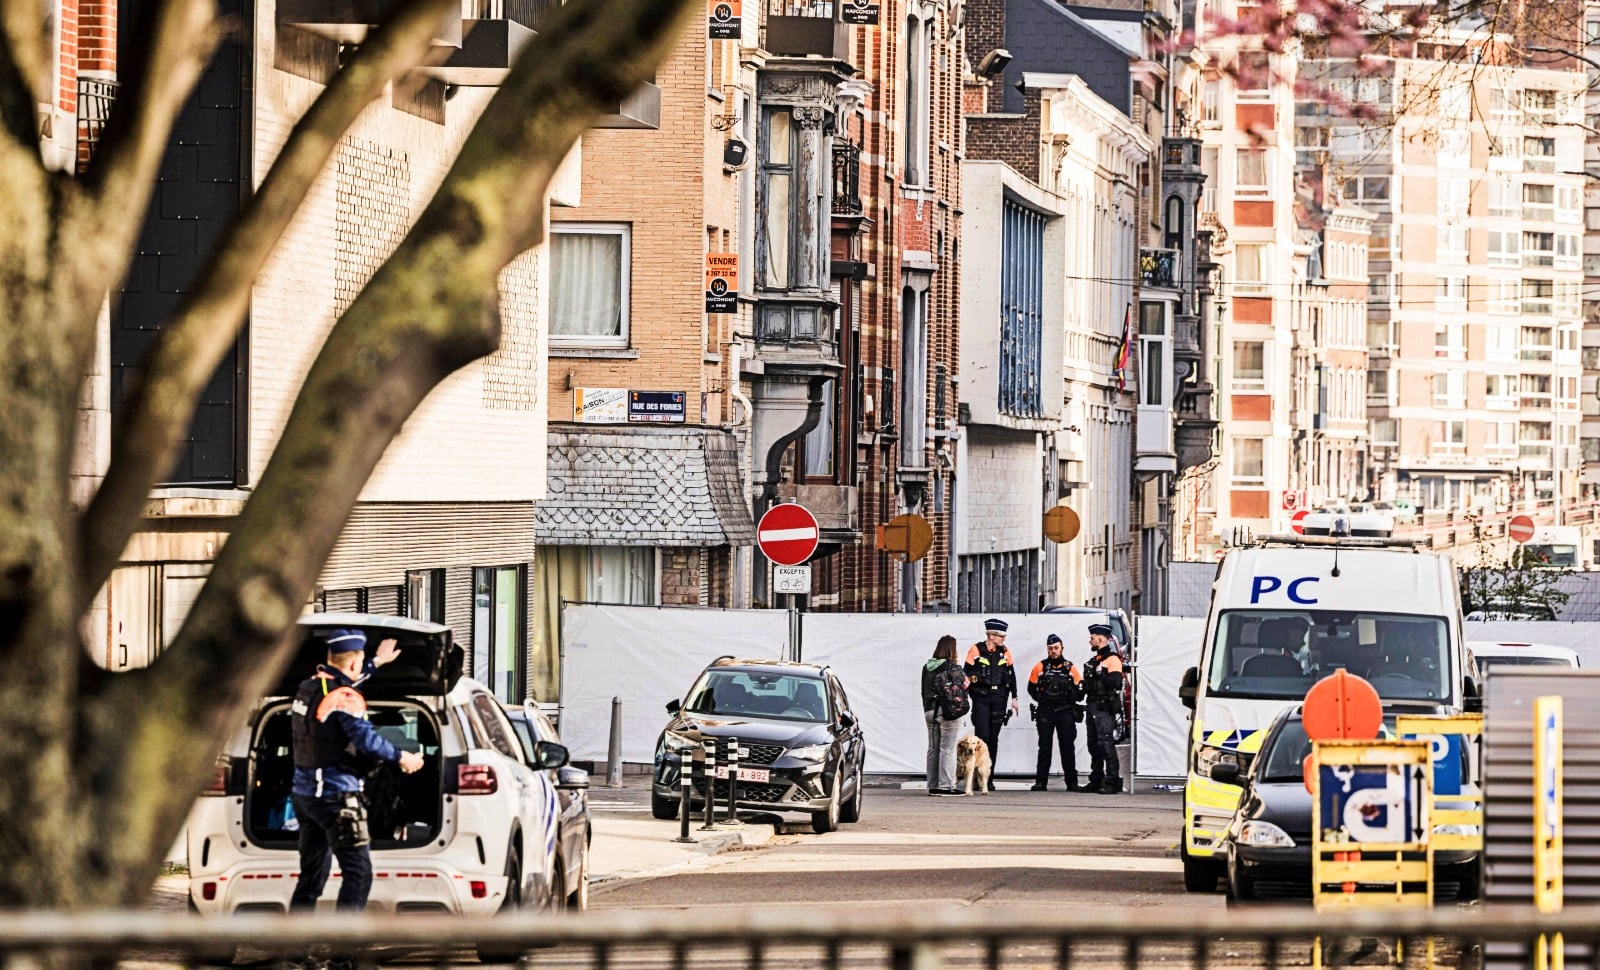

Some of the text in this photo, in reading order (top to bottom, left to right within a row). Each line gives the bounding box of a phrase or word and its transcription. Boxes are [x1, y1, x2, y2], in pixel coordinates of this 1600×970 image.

[708, 257, 737, 266] VENDRE
[632, 402, 645, 410] RUE
[1250, 576, 1321, 604] PC
